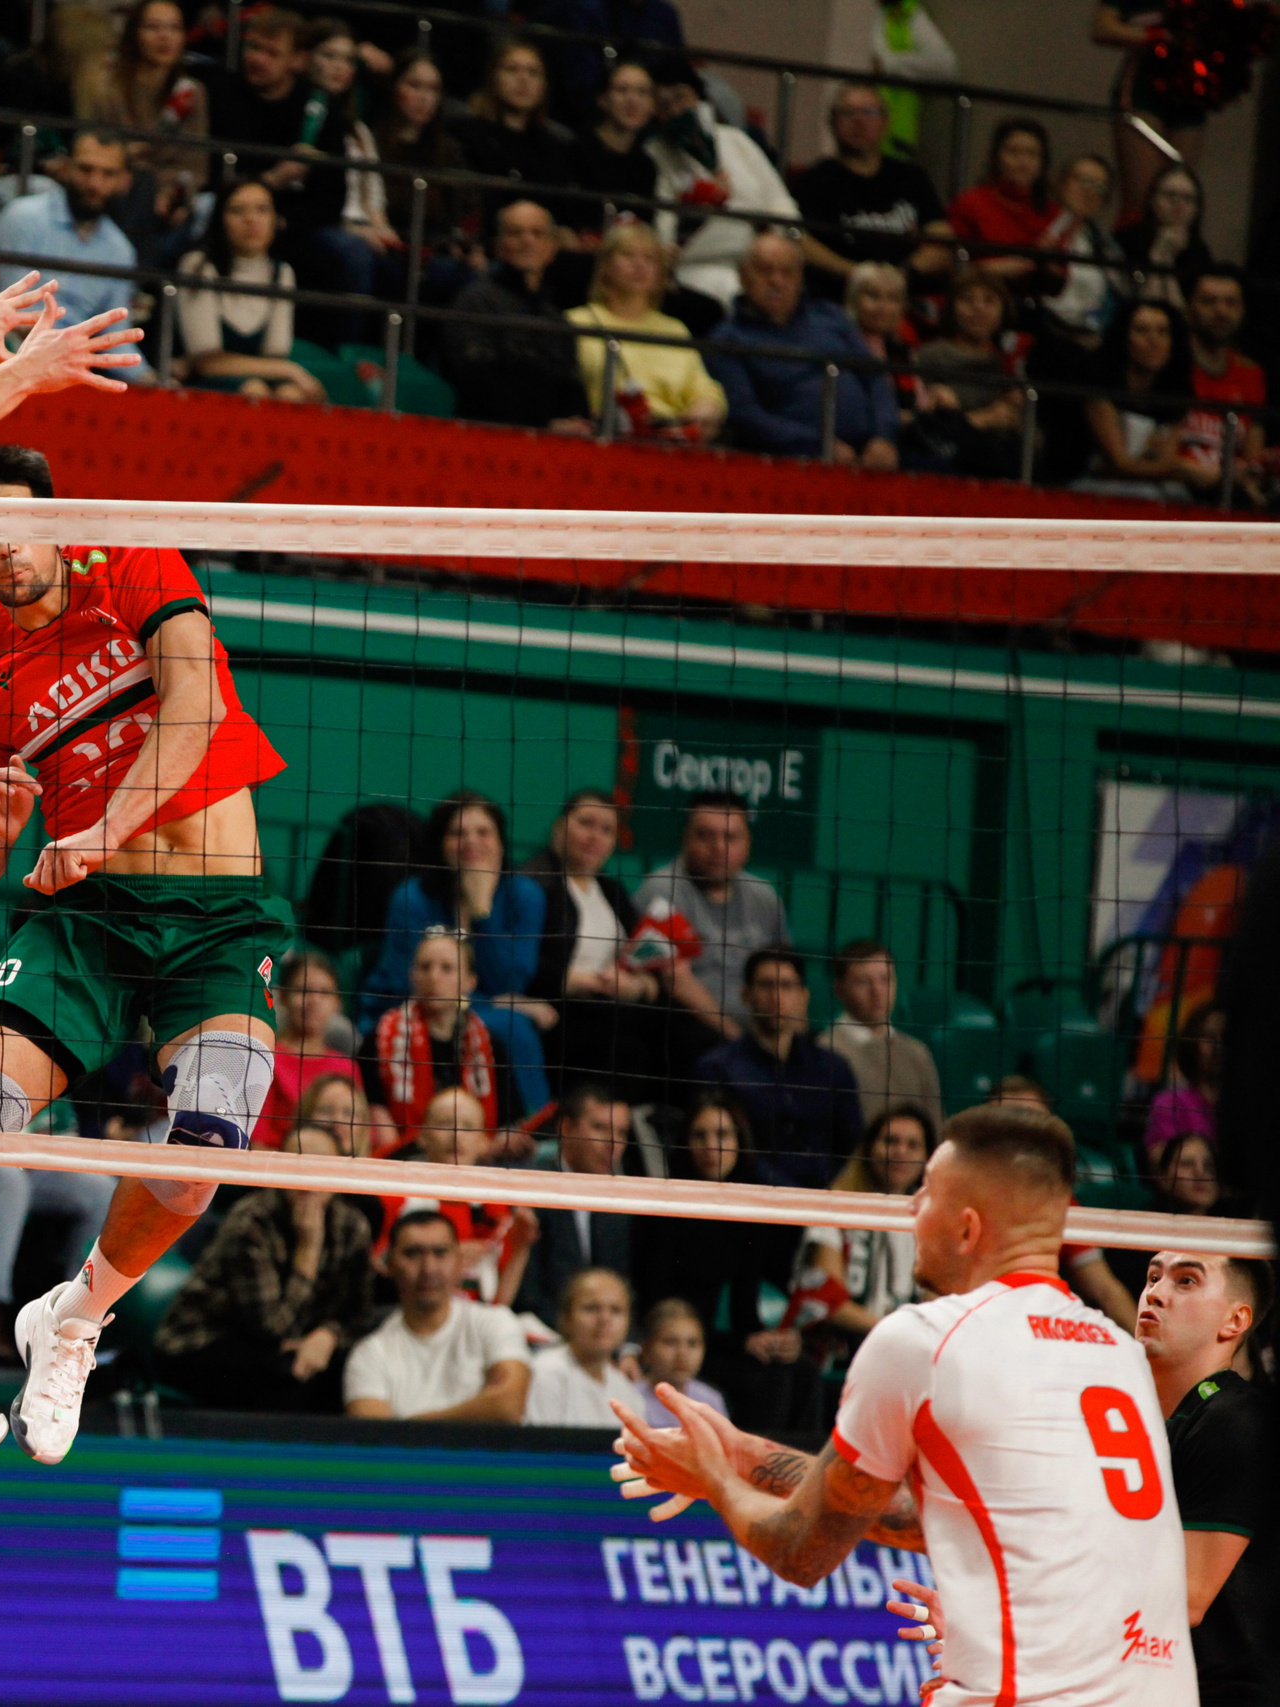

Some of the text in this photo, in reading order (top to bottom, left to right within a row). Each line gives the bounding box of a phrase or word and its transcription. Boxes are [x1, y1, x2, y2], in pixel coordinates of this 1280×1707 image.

[653, 739, 772, 806] Сектор
[1080, 1385, 1164, 1521] 9
[245, 1528, 525, 1706] ВТБ
